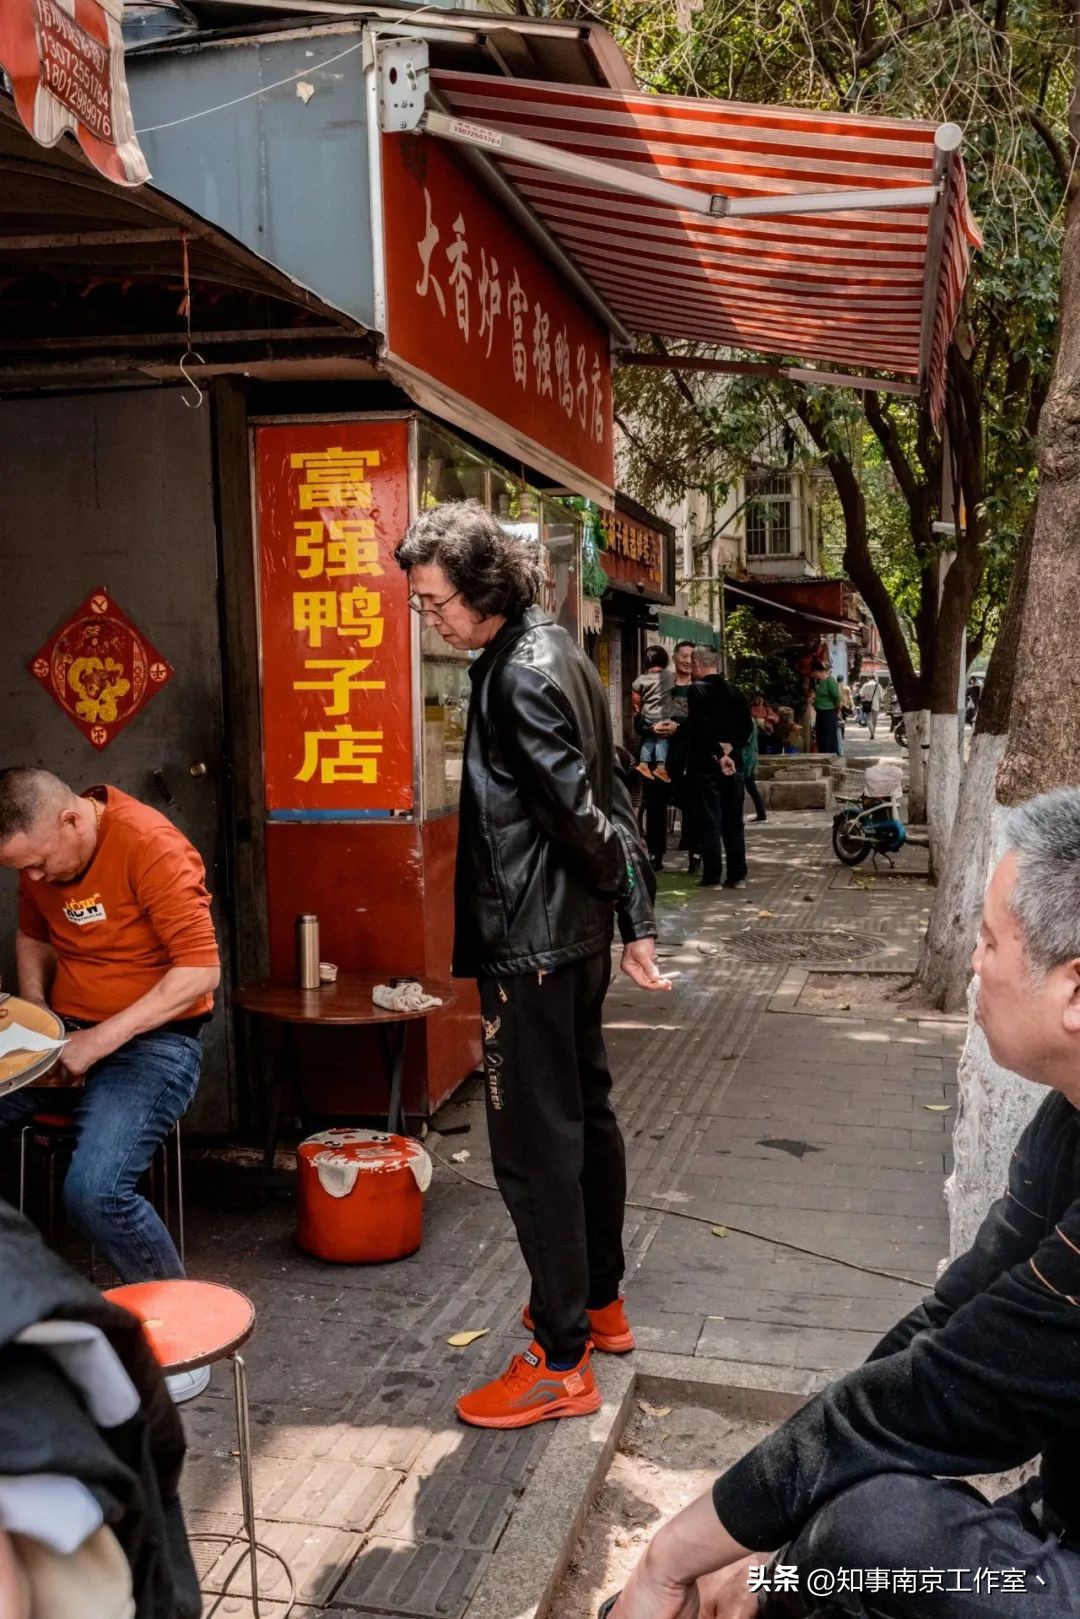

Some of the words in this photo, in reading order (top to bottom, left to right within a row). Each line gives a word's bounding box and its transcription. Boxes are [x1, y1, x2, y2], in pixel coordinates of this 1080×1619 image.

[41, 30, 109, 110] 13072551764
[44, 58, 111, 137] 18012989976
[416, 187, 603, 444] 大香炉富强鸭子店
[290, 446, 386, 784] 富强鸭子店
